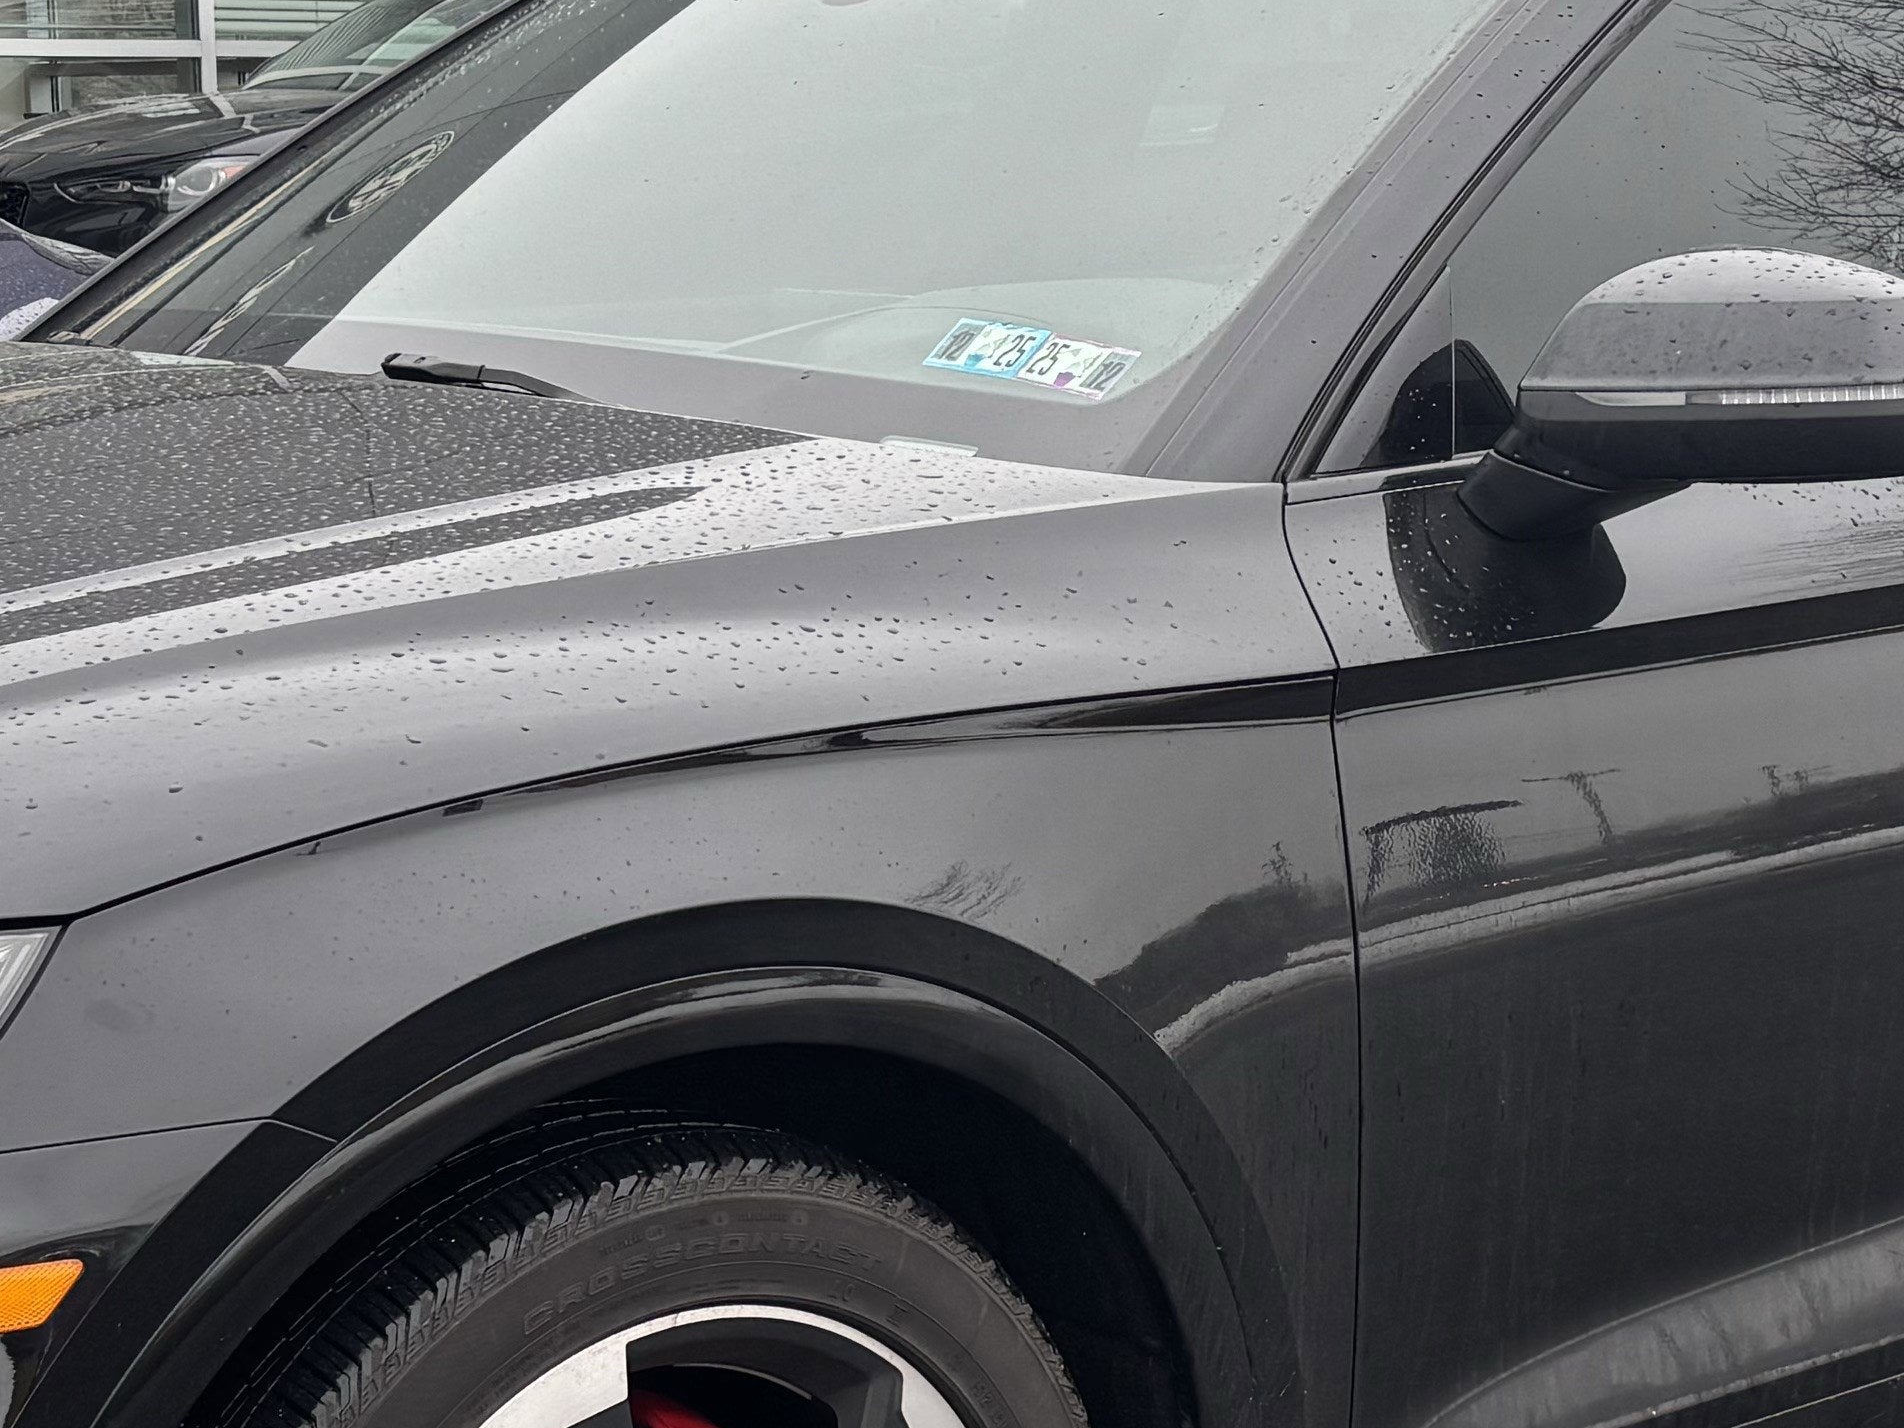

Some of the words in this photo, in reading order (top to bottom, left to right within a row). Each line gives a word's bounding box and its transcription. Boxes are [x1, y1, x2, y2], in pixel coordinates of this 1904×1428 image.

[994, 334, 1036, 368] 25
[1026, 341, 1070, 376] 25
[1086, 360, 1126, 392] 12
